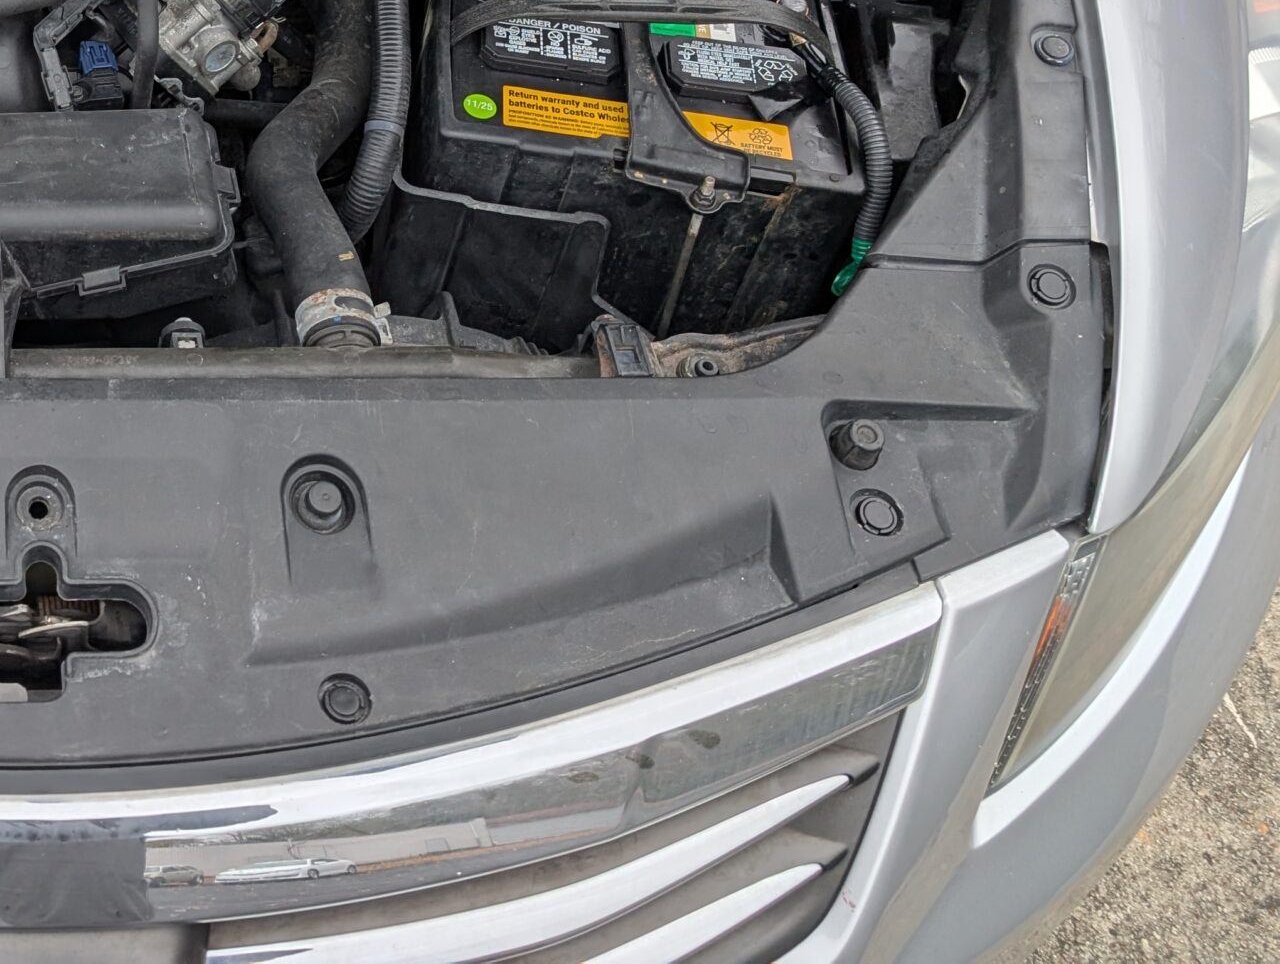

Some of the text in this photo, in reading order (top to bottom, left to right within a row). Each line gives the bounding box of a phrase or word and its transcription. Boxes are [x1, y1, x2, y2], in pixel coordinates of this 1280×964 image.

[562, 23, 601, 34] POISON
[466, 99, 493, 111] 11/25
[508, 89, 624, 113] Return warranty and used
[508, 99, 549, 113] batteries
[551, 105, 561, 113] to
[562, 107, 596, 119] Costco
[740, 142, 766, 151] BATTERY
